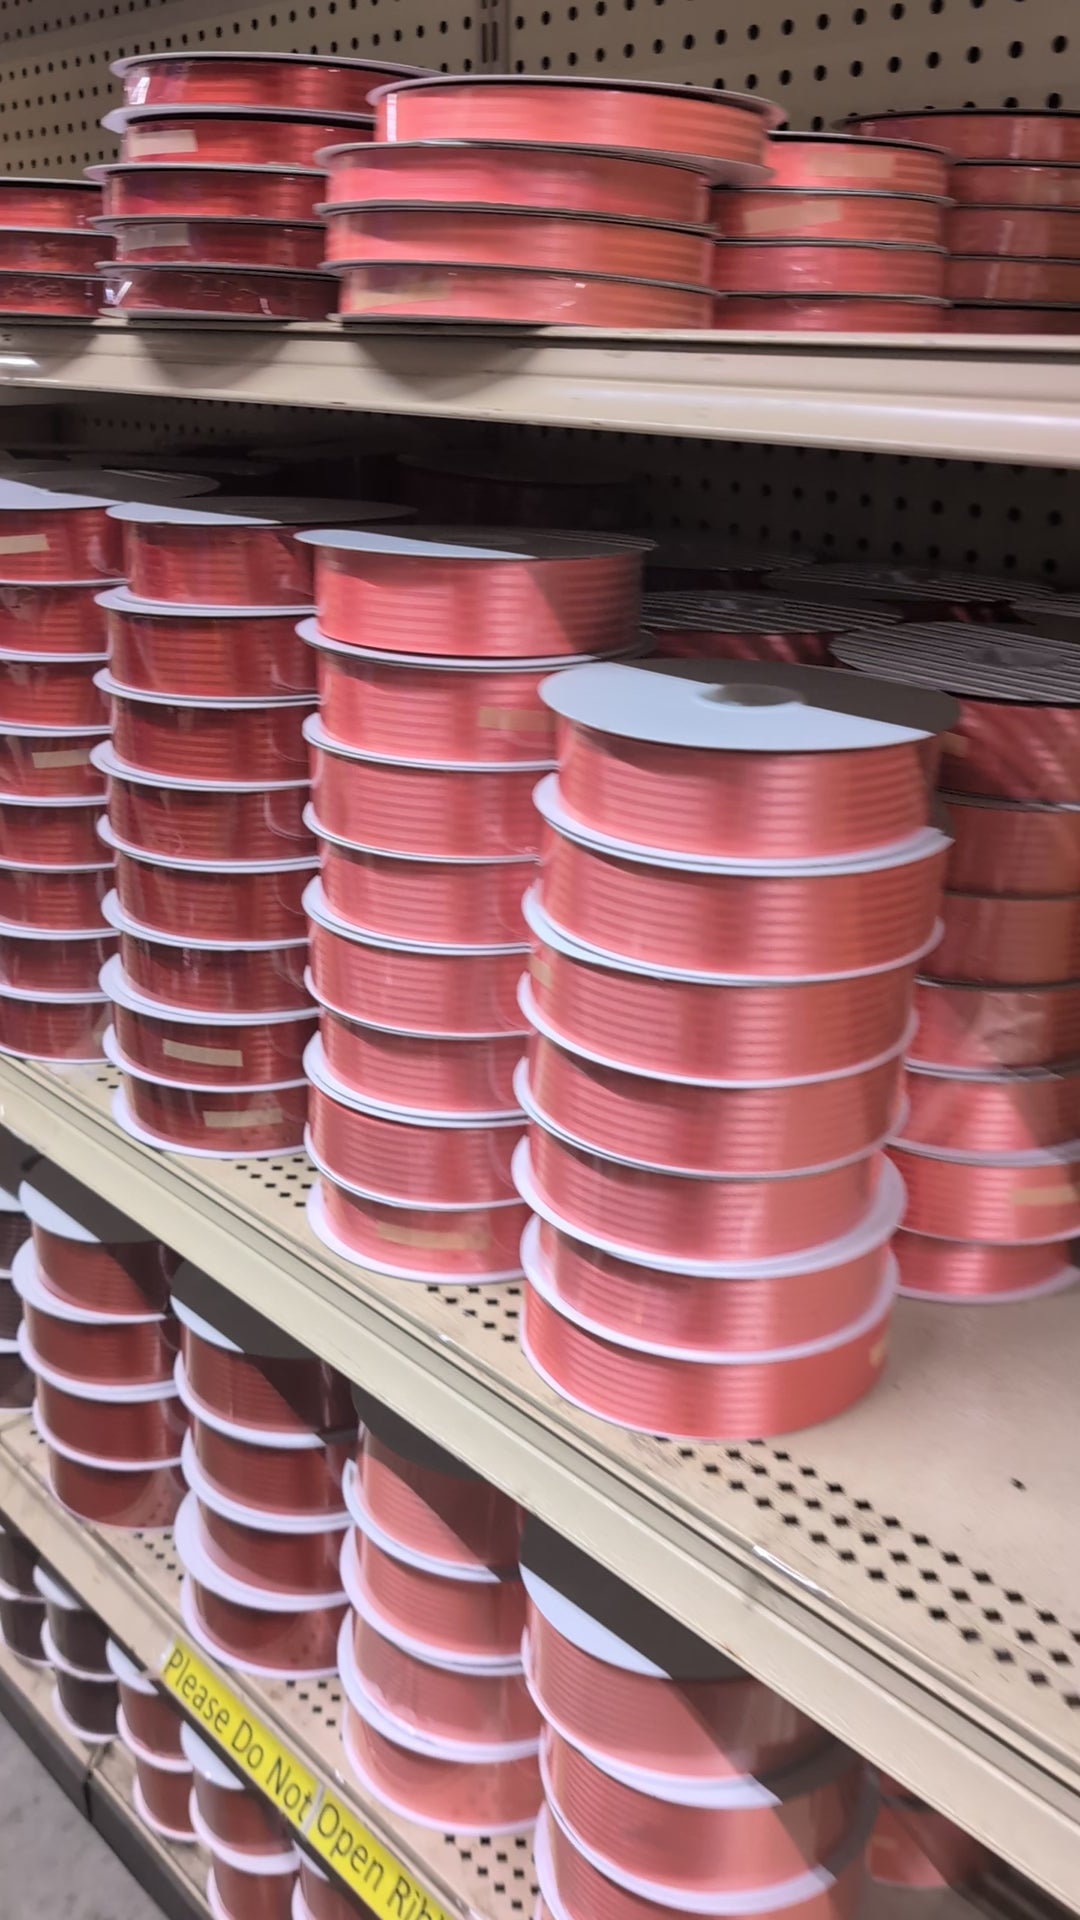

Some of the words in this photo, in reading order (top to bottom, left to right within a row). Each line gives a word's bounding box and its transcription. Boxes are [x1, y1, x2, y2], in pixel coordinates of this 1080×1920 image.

[166, 1649, 231, 1732] Please
[232, 1720, 264, 1769] Do
[266, 1756, 313, 1821] Not
[317, 1803, 384, 1892] Open
